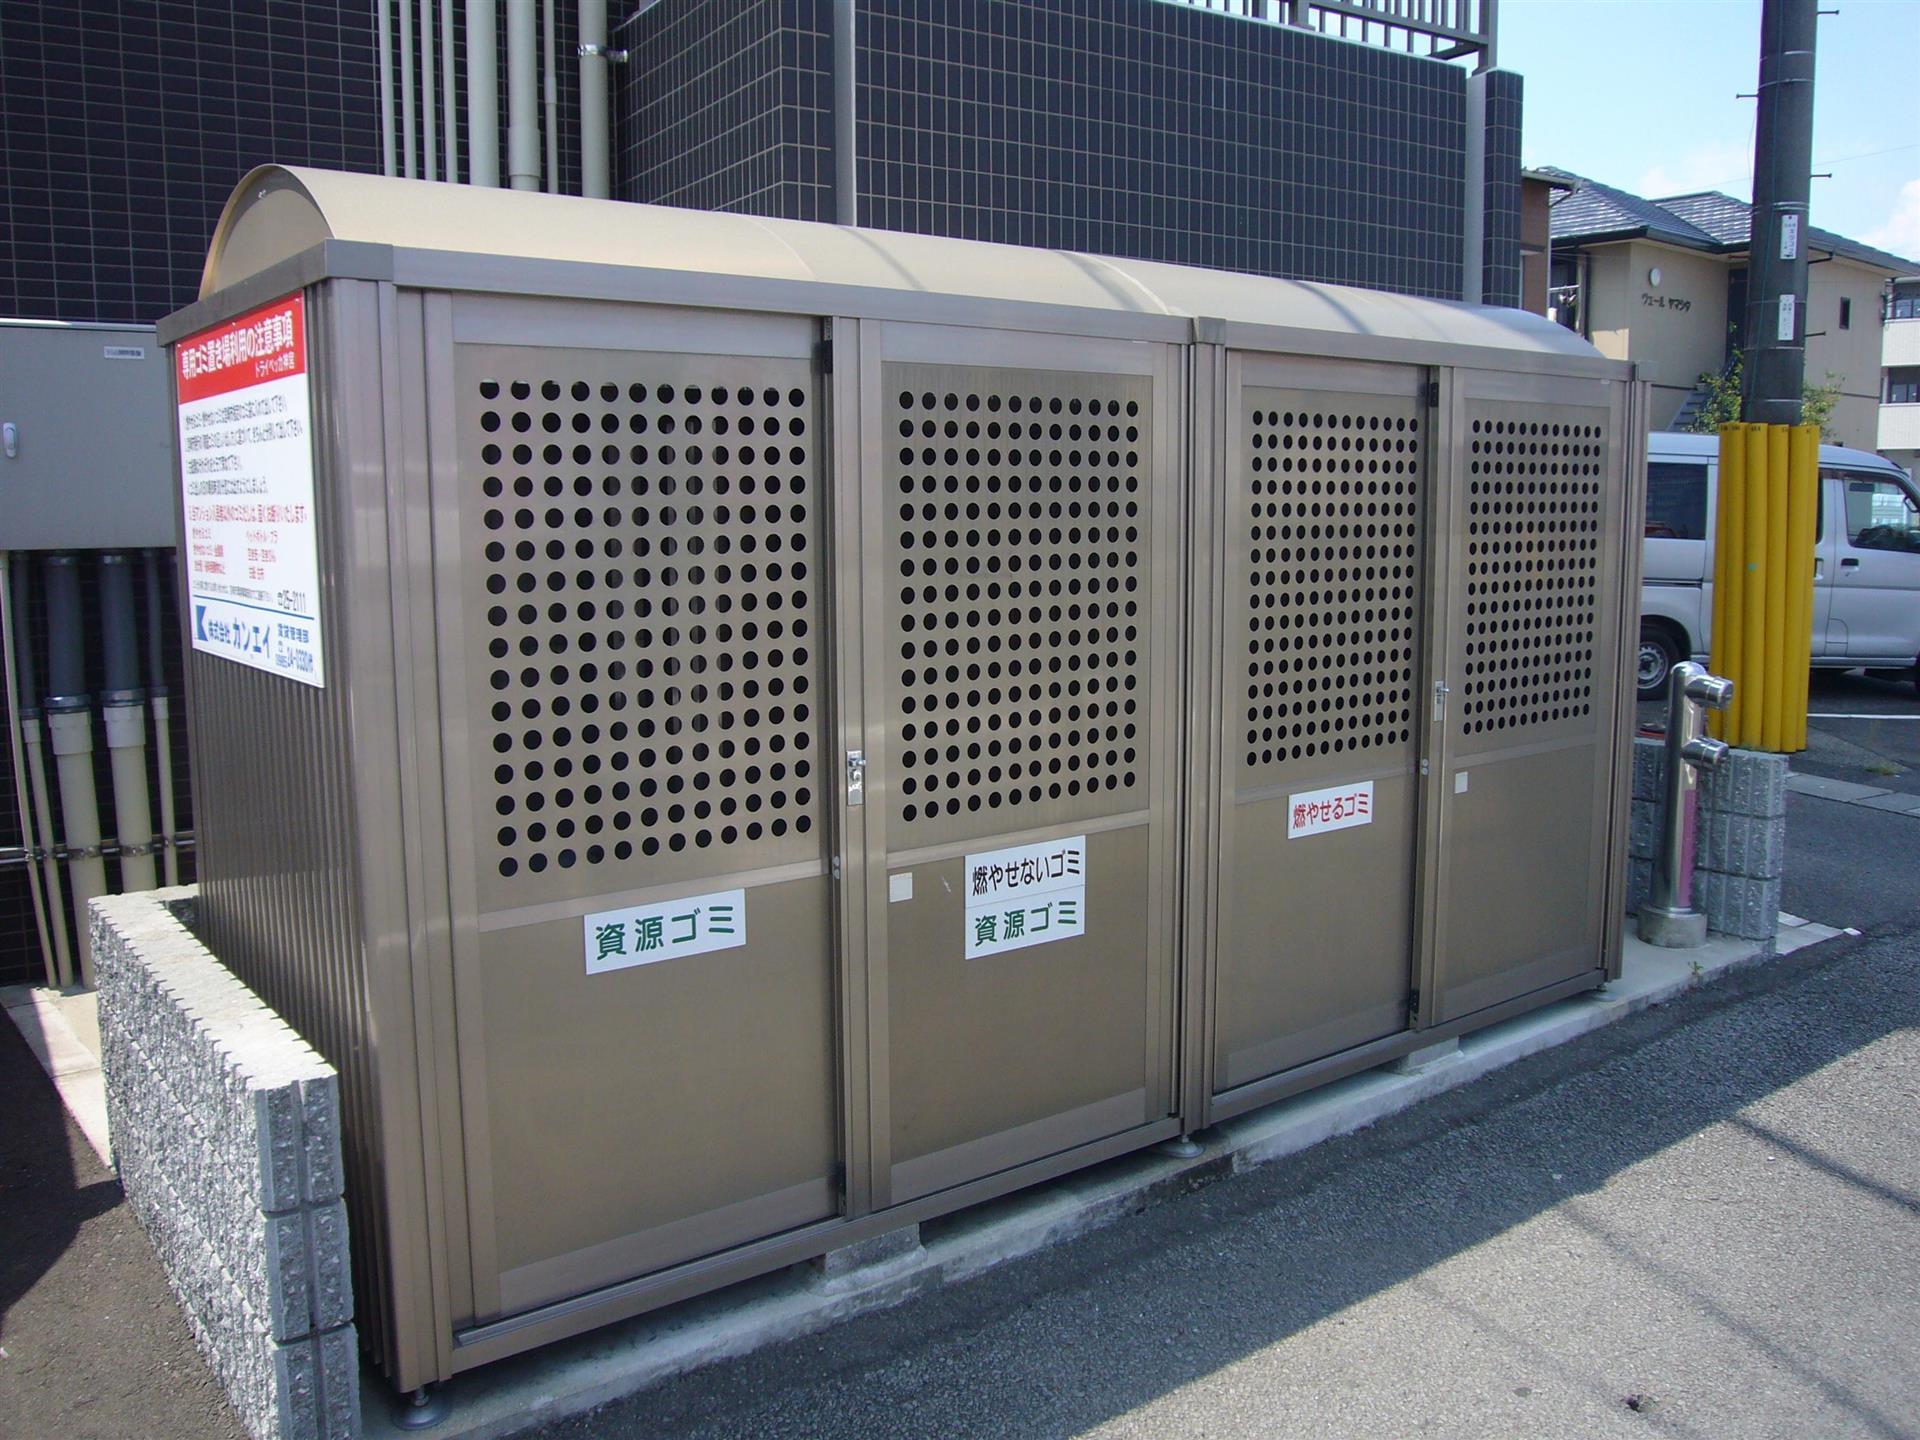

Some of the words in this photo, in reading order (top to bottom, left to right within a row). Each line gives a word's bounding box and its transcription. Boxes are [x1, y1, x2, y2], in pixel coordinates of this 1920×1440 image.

[1292, 793, 1369, 829] 燃やせるゴミ
[972, 849, 1081, 896] 燃やせないゴミ
[595, 905, 735, 961] 資源ゴミ
[974, 900, 1078, 948] 資源ゴミ
